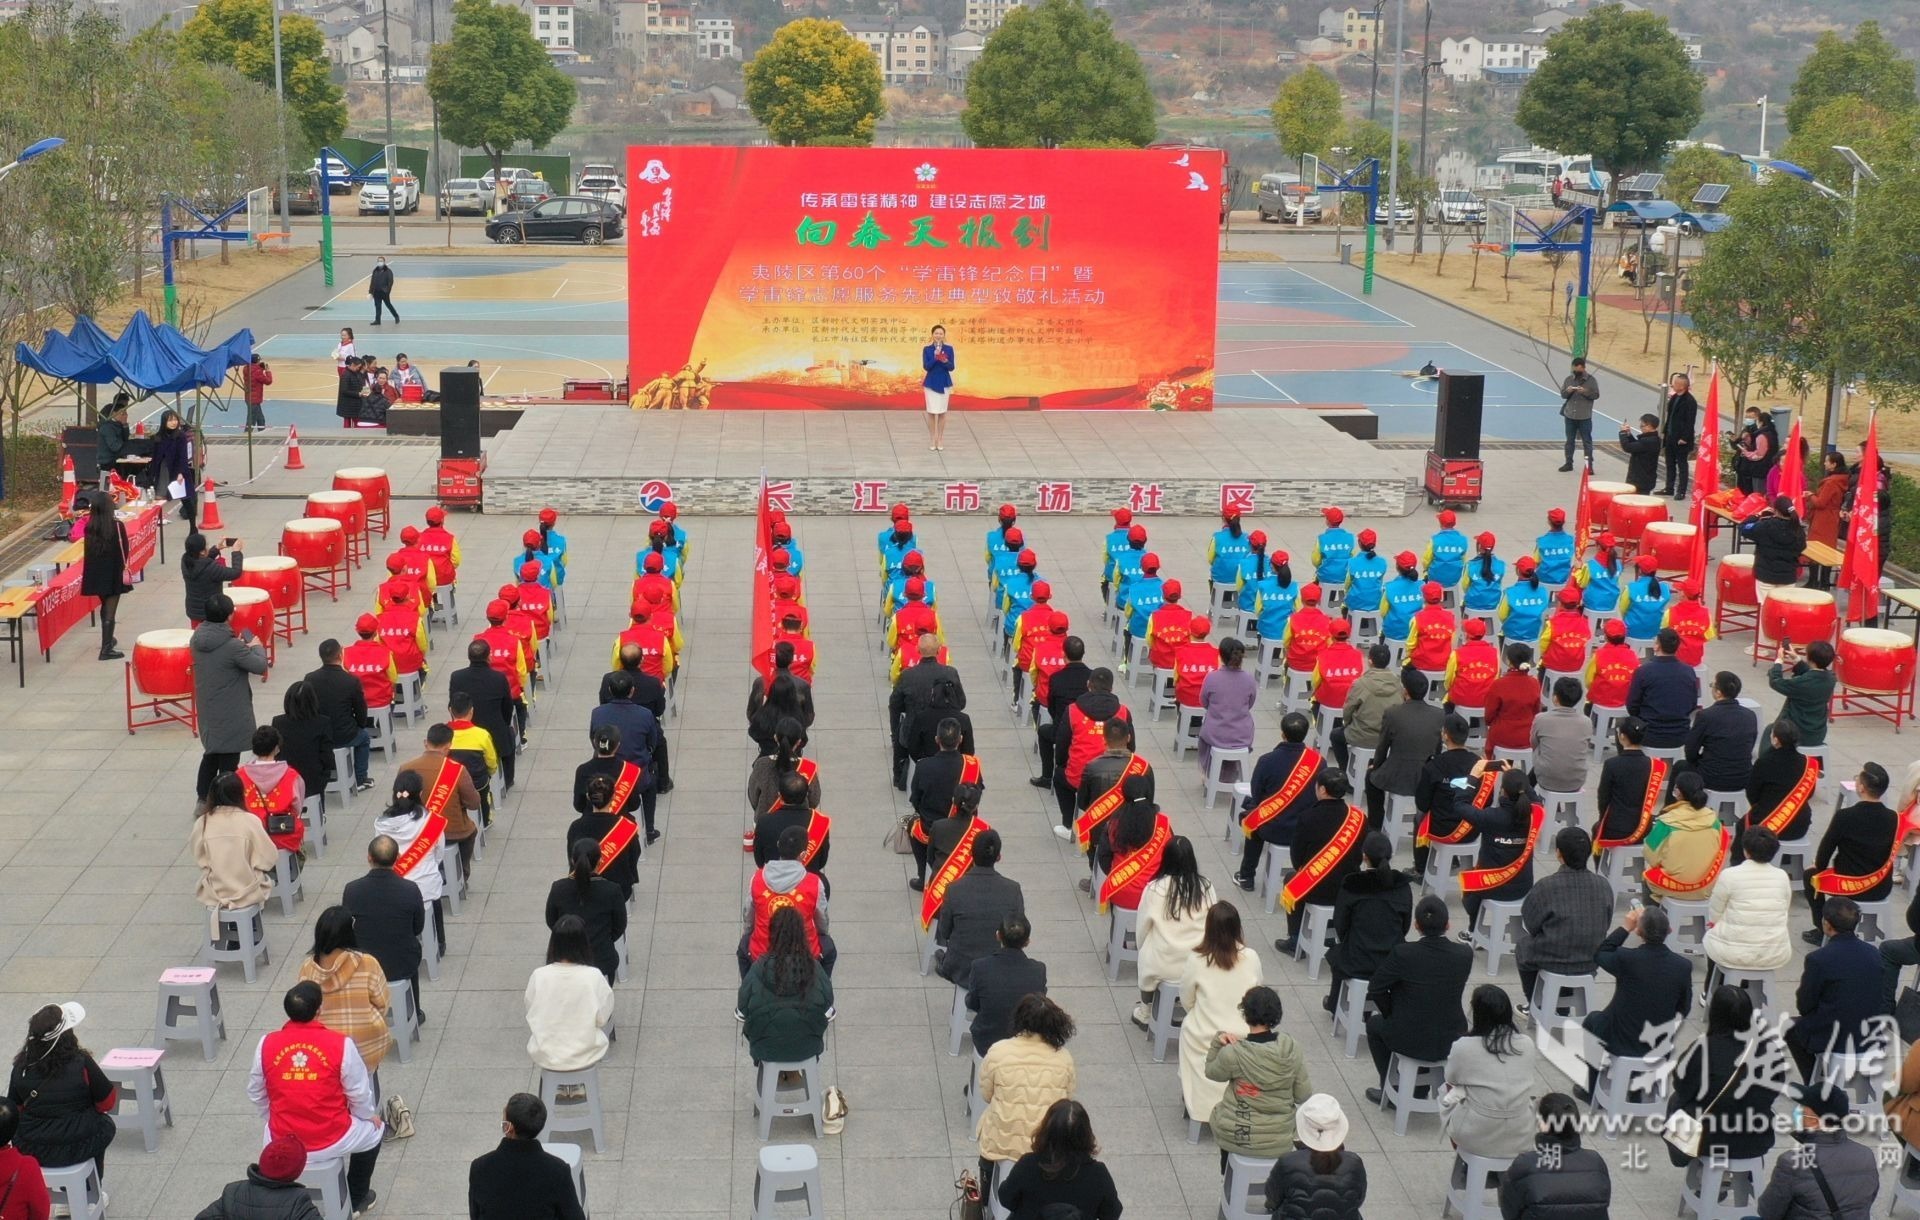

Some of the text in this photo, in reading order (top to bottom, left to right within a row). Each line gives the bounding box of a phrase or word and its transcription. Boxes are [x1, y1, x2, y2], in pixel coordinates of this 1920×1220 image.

[800, 192, 1046, 210] 传承雷锋精神 建设志愿之城
[795, 210, 1051, 252] 向春天报到
[752, 264, 886, 281] 夷陵区第60个
[1073, 266, 1094, 283] 暨
[739, 286, 1105, 304] 学雷锋志愿服务先进典型致敬礼活动
[766, 481, 1256, 513] 长江市场社区
